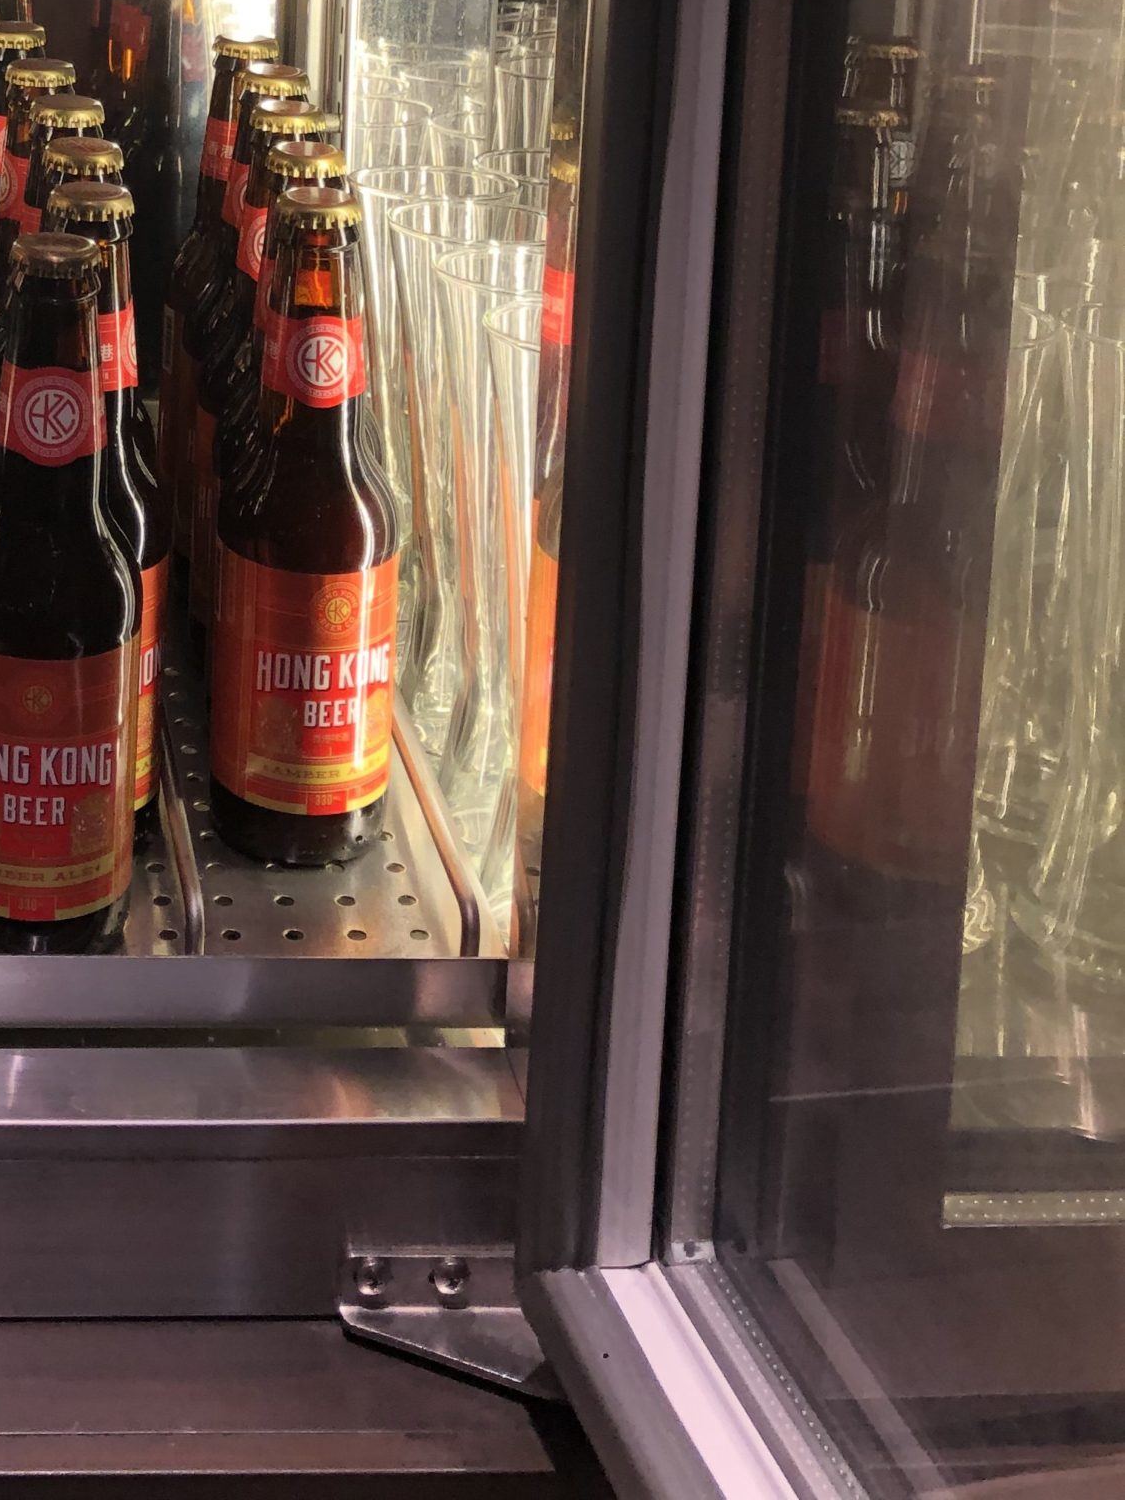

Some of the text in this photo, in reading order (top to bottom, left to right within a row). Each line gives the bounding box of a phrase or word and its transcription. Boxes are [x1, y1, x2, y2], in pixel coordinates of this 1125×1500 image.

[256, 642, 391, 693] HONG KONG
[303, 698, 359, 728] BEER
[38, 742, 113, 787] KONG
[272, 764, 340, 781] AMBER
[2, 793, 66, 827] BEER
